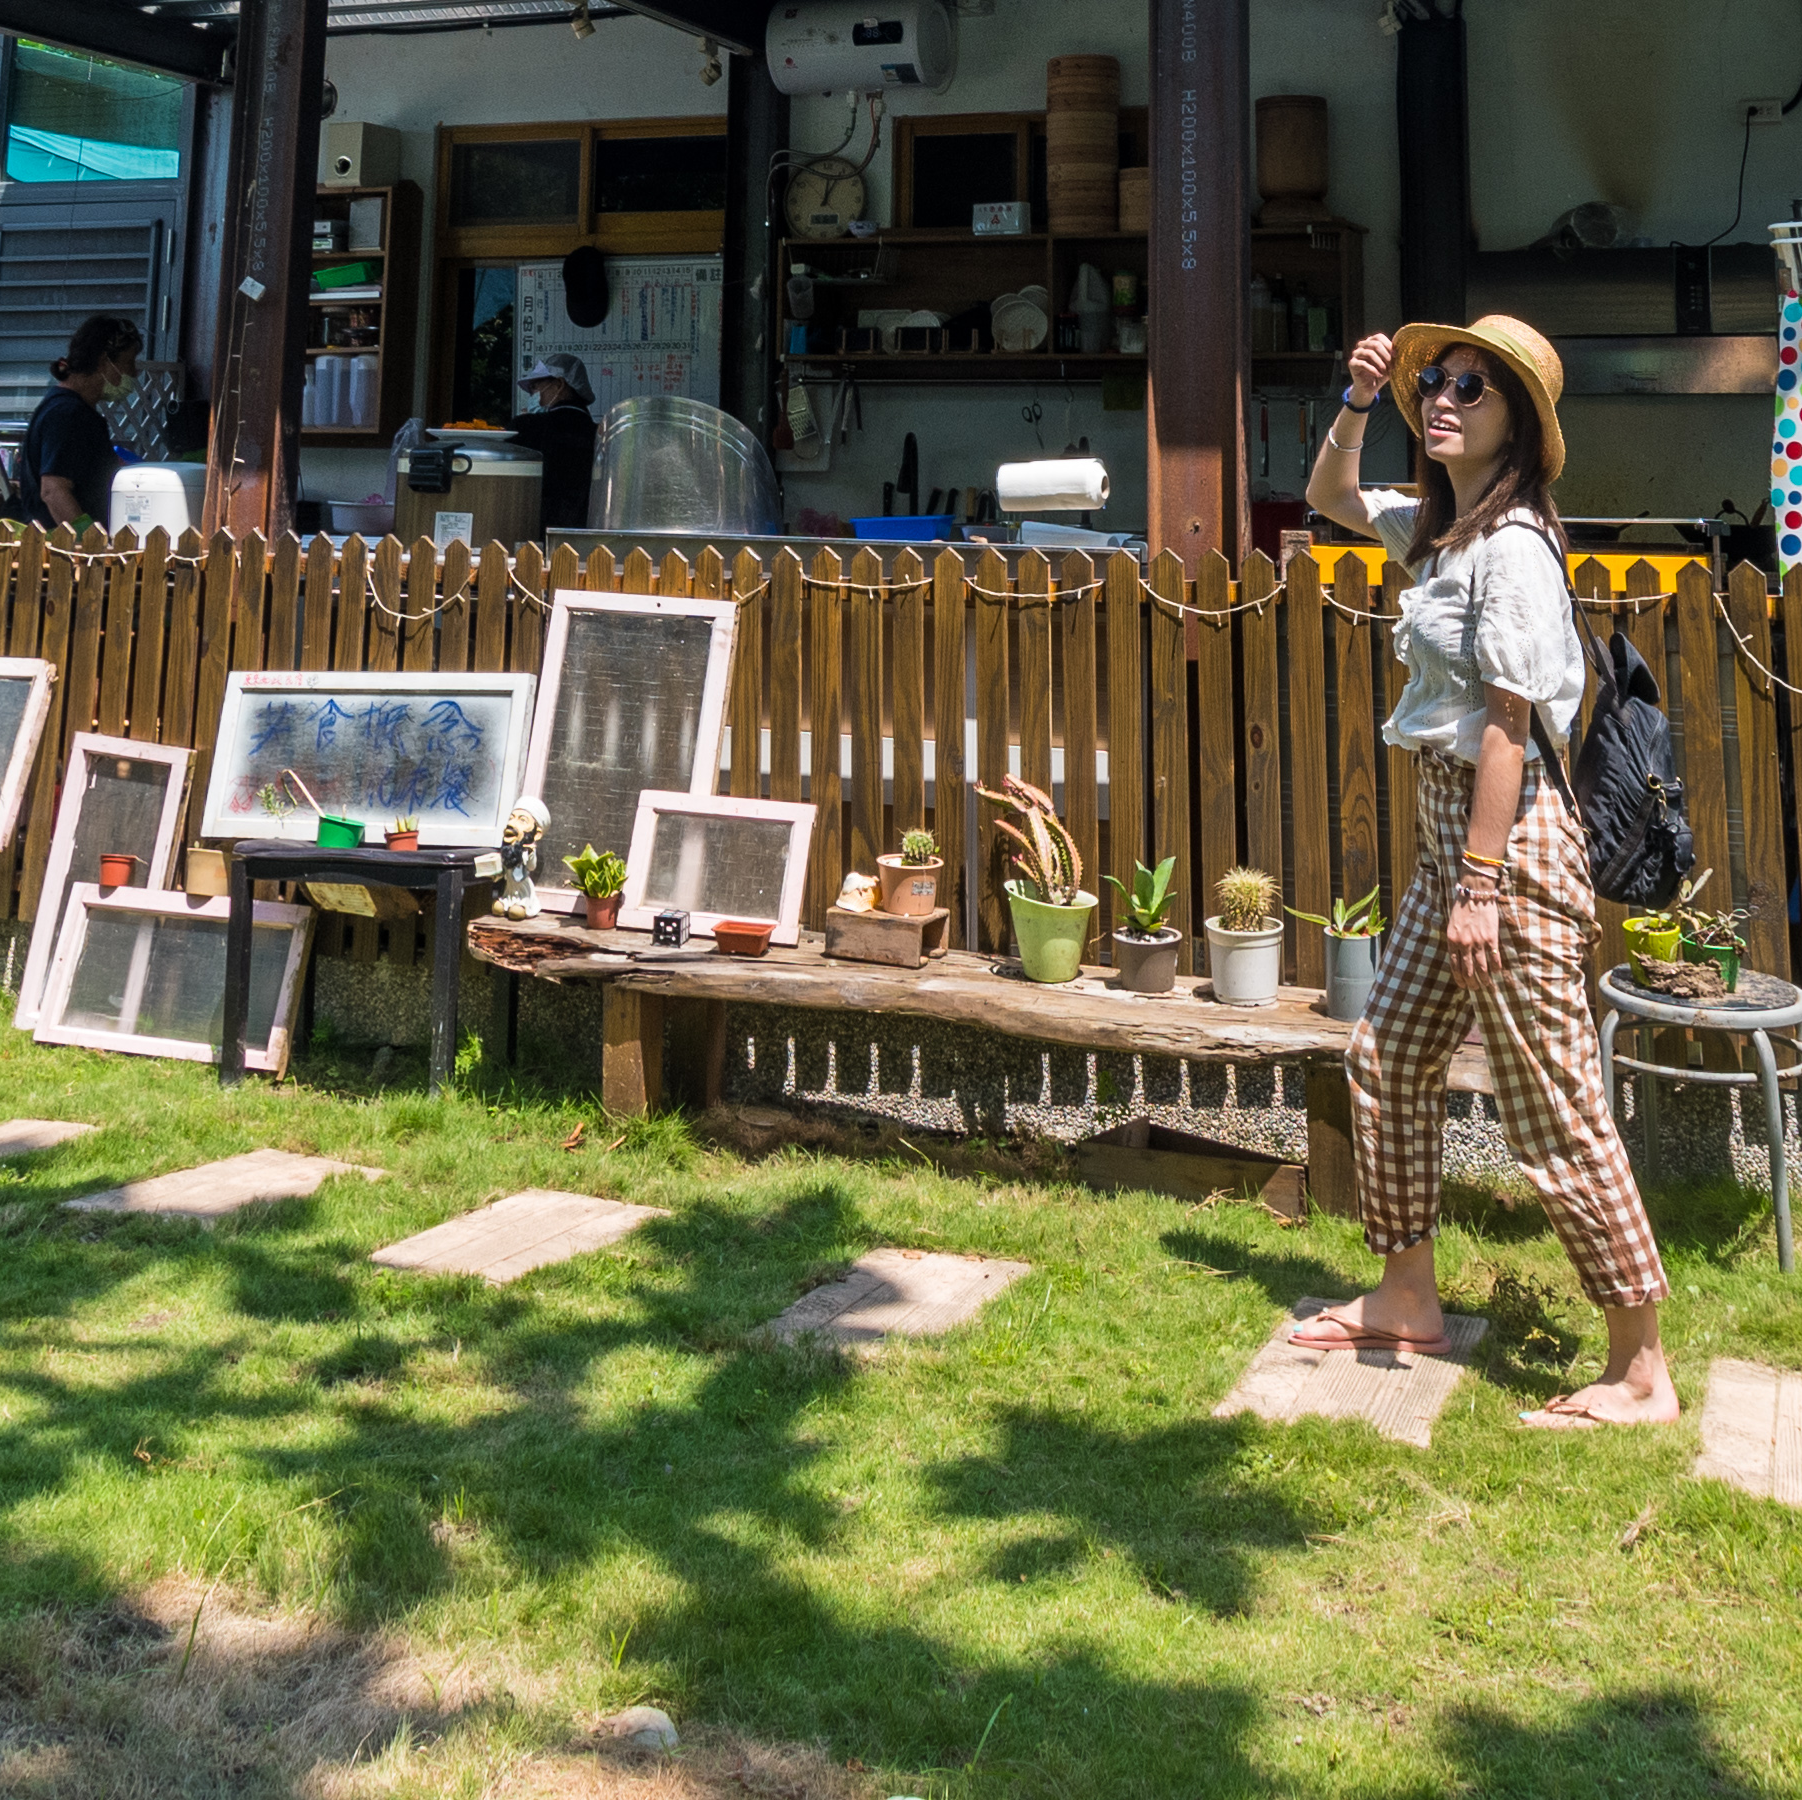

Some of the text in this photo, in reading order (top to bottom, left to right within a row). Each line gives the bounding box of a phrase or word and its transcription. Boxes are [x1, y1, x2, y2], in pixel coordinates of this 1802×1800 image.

[1181, 88, 1197, 271] H200x100x5.5x8
[522, 295, 534, 377] 月份行事
